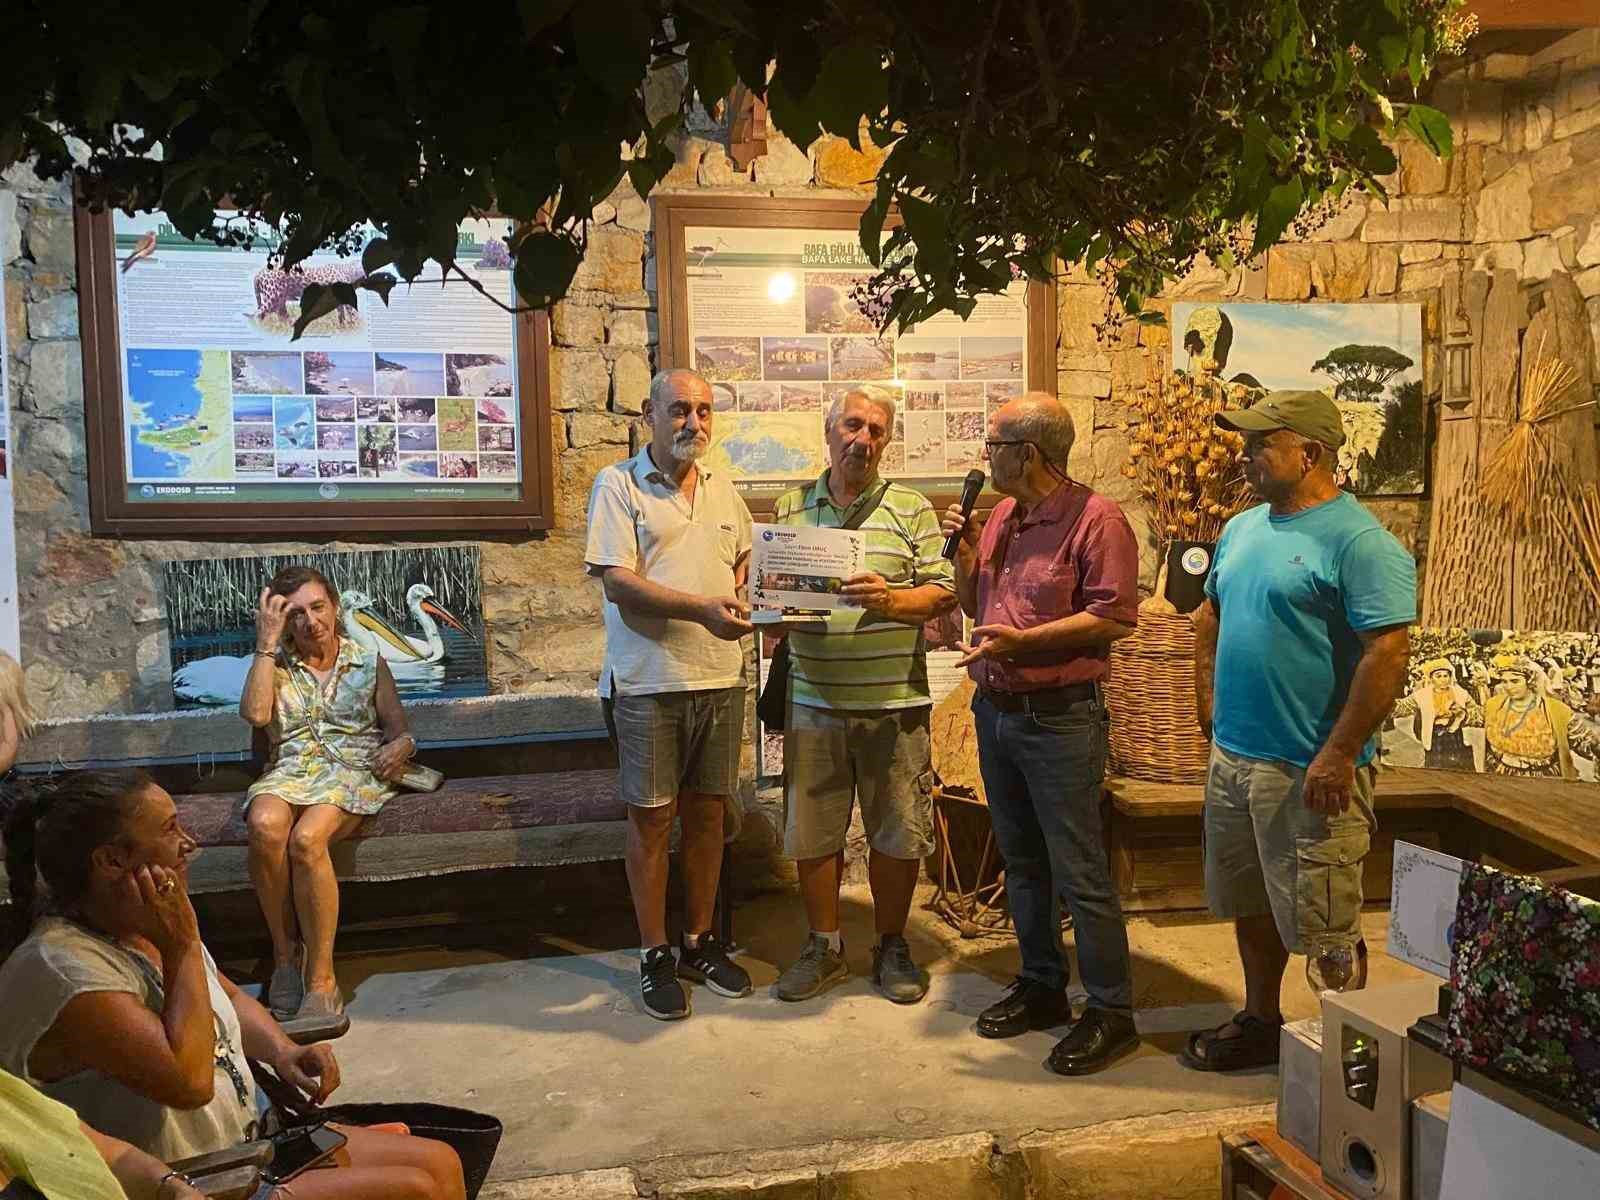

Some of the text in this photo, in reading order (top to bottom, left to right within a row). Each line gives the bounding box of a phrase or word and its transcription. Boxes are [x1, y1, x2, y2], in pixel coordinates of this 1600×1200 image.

[804, 243, 829, 256] BAFA
[830, 241, 854, 257] GÖLÜ
[801, 255, 826, 265] BAFA
[828, 255, 853, 265] LAKE
